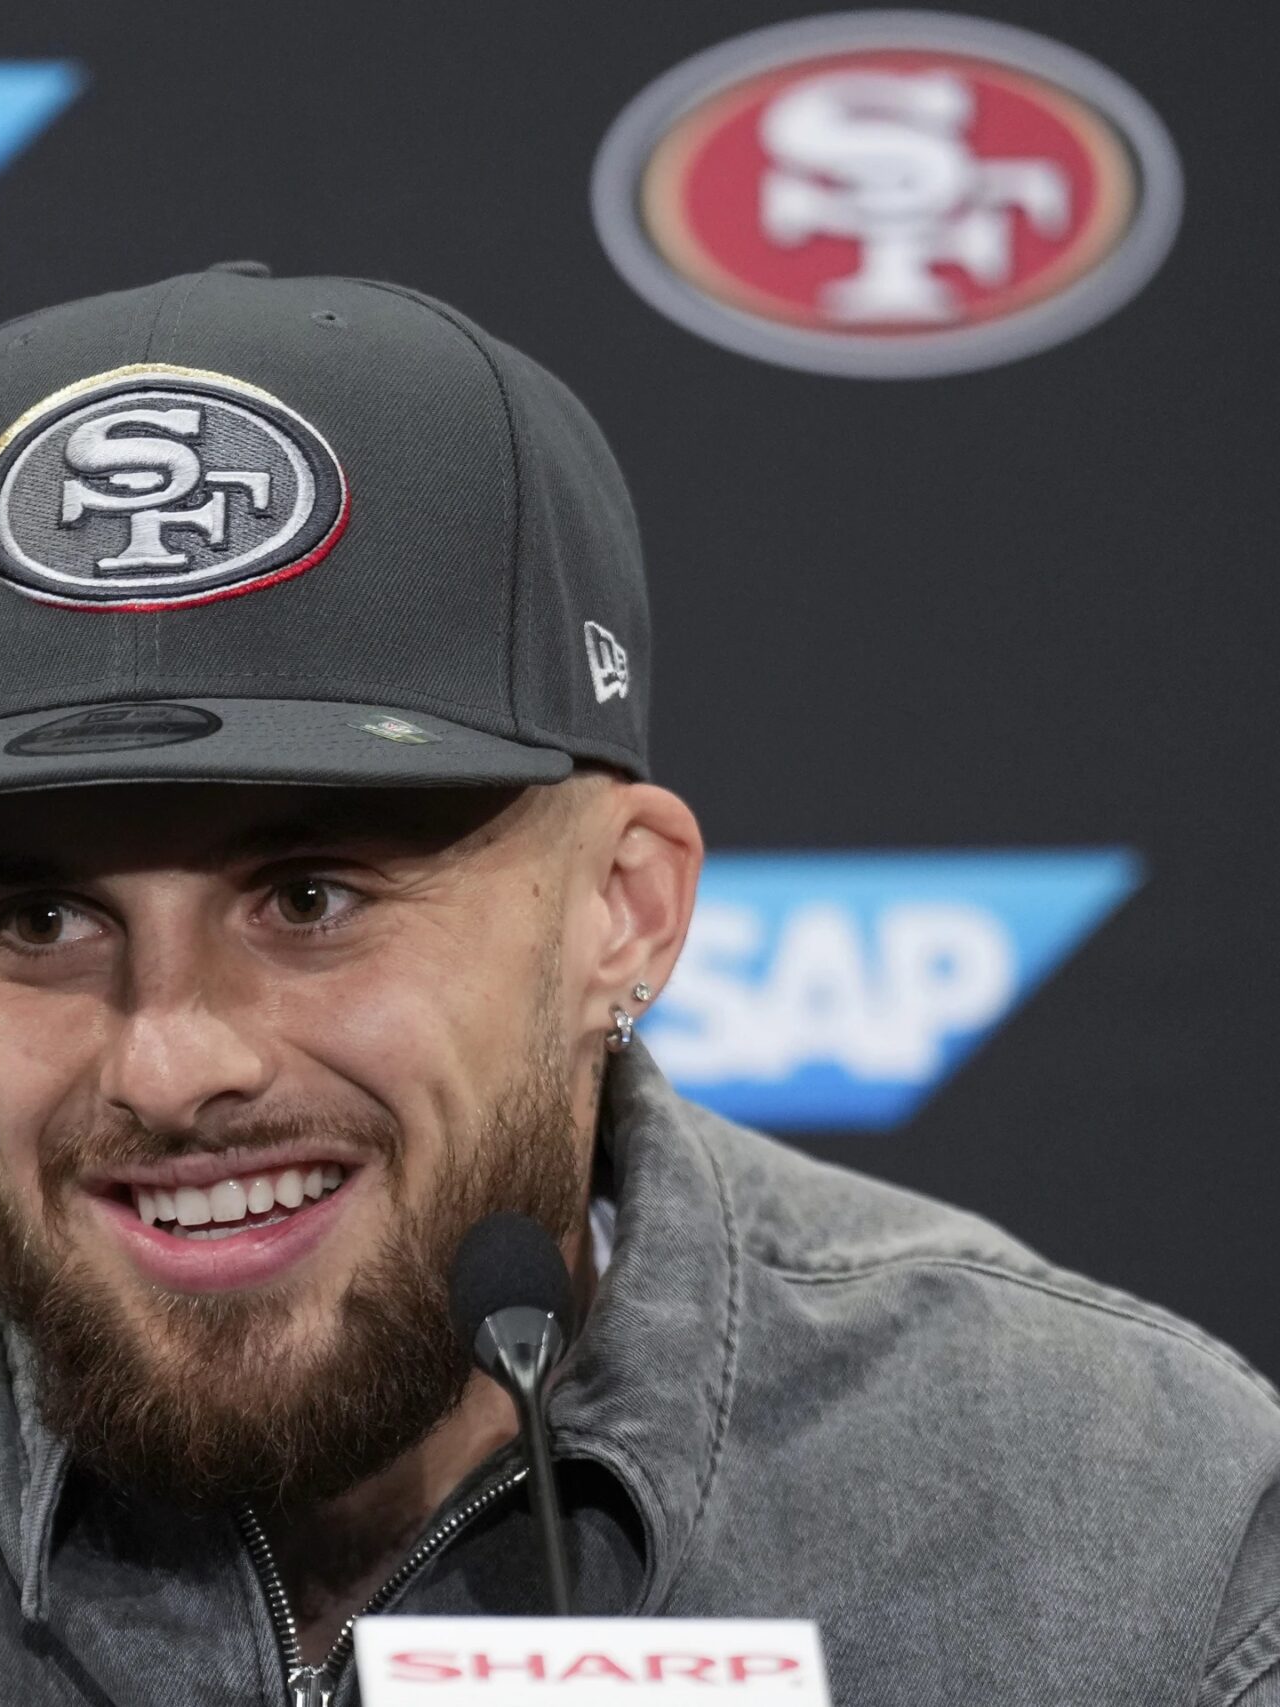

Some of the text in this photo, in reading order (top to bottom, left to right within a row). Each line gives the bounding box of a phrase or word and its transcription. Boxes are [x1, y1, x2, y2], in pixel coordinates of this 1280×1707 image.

[760, 70, 1070, 322] SF
[60, 408, 272, 572] SF
[645, 902, 1011, 1083] SAP
[389, 1650, 801, 1683] SHARP
